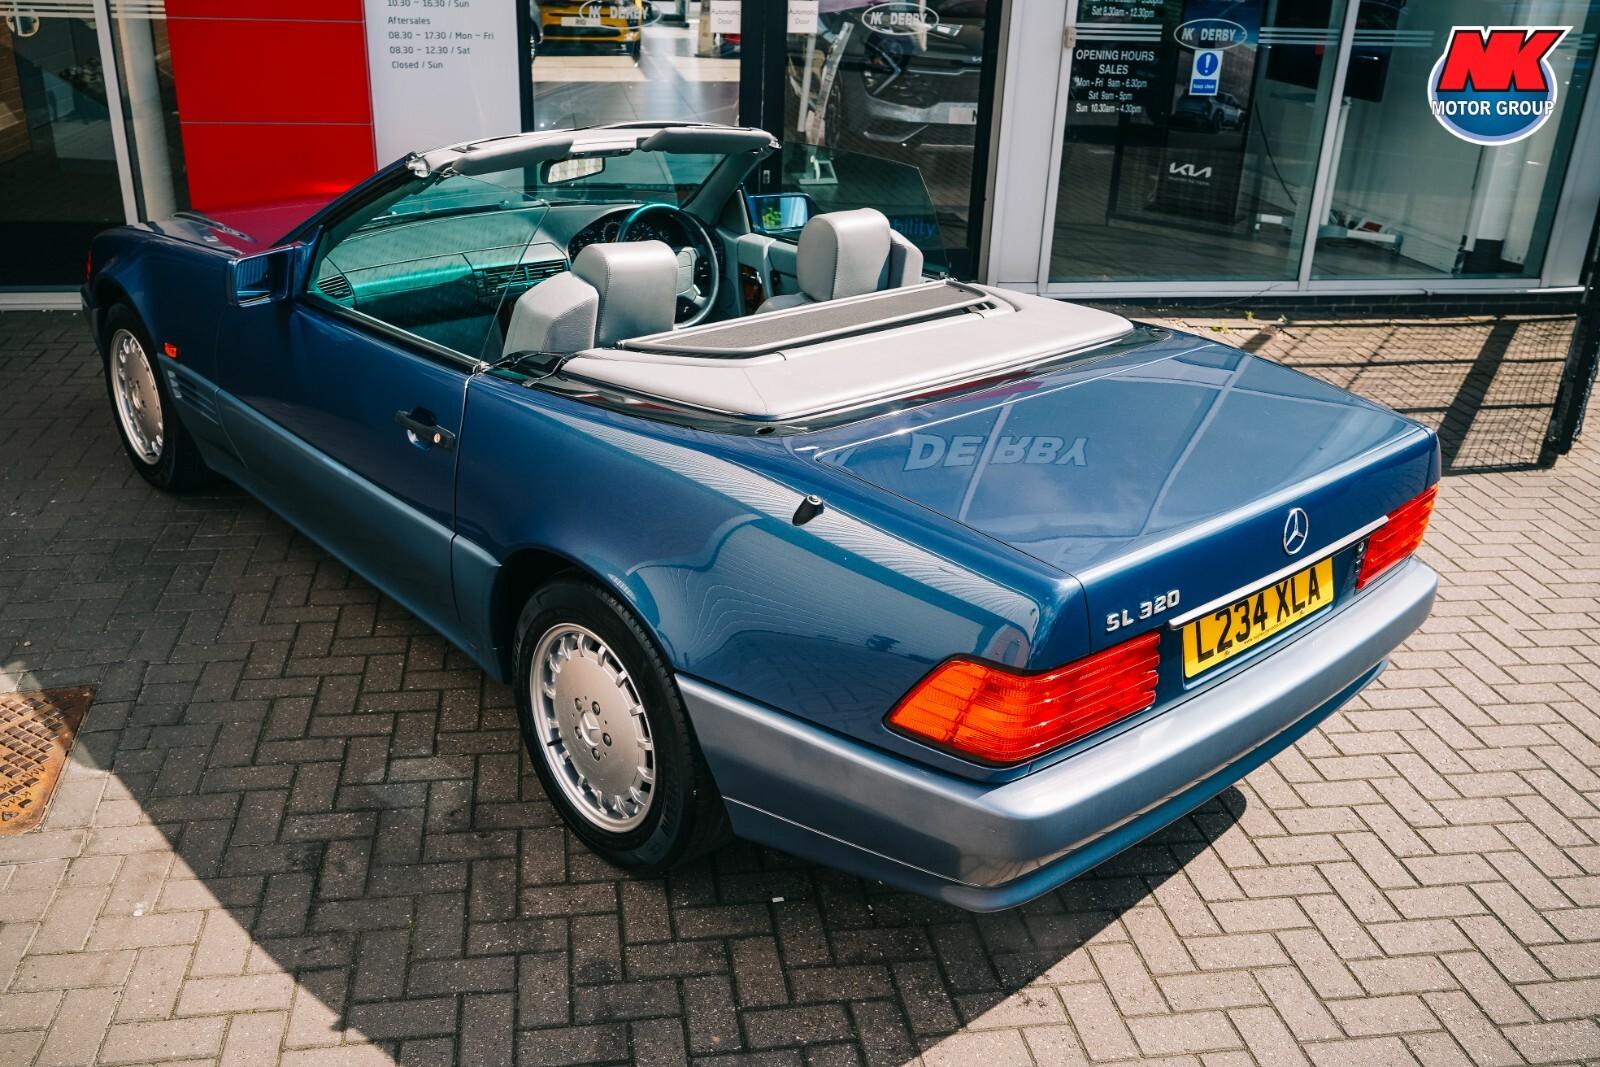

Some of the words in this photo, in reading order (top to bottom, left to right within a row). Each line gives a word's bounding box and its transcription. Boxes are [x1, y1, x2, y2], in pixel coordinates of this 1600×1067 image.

[455, 0, 470, 8] Sun
[1091, 5, 1103, 16] Sat
[1130, 7, 1155, 19] 12.30pm
[387, 16, 432, 25] Aftersales
[388, 31, 412, 40] 08.30
[424, 31, 446, 40] 17.30
[455, 32, 473, 40] Mon
[483, 32, 494, 40] Fri
[1201, 28, 1237, 42] DERBY
[389, 46, 414, 55] 08.30
[425, 46, 448, 55] 12.30
[457, 46, 470, 55] Sat
[1075, 50, 1119, 60] OPENING
[1121, 51, 1155, 61] HOURS
[391, 61, 419, 69] Closed
[428, 61, 443, 69] Sun
[1098, 64, 1129, 75] SALES
[1076, 77, 1091, 87] Mon
[1094, 77, 1104, 87] Fri
[1107, 78, 1121, 88] 9am
[1088, 90, 1099, 100] Sat
[1076, 103, 1088, 112] Sun
[1120, 104, 1142, 114] 4.30pm
[1106, 609, 1135, 632] SL
[1139, 589, 1180, 620] 320
[1196, 591, 1269, 664] L234
[1276, 566, 1321, 623] XLA
